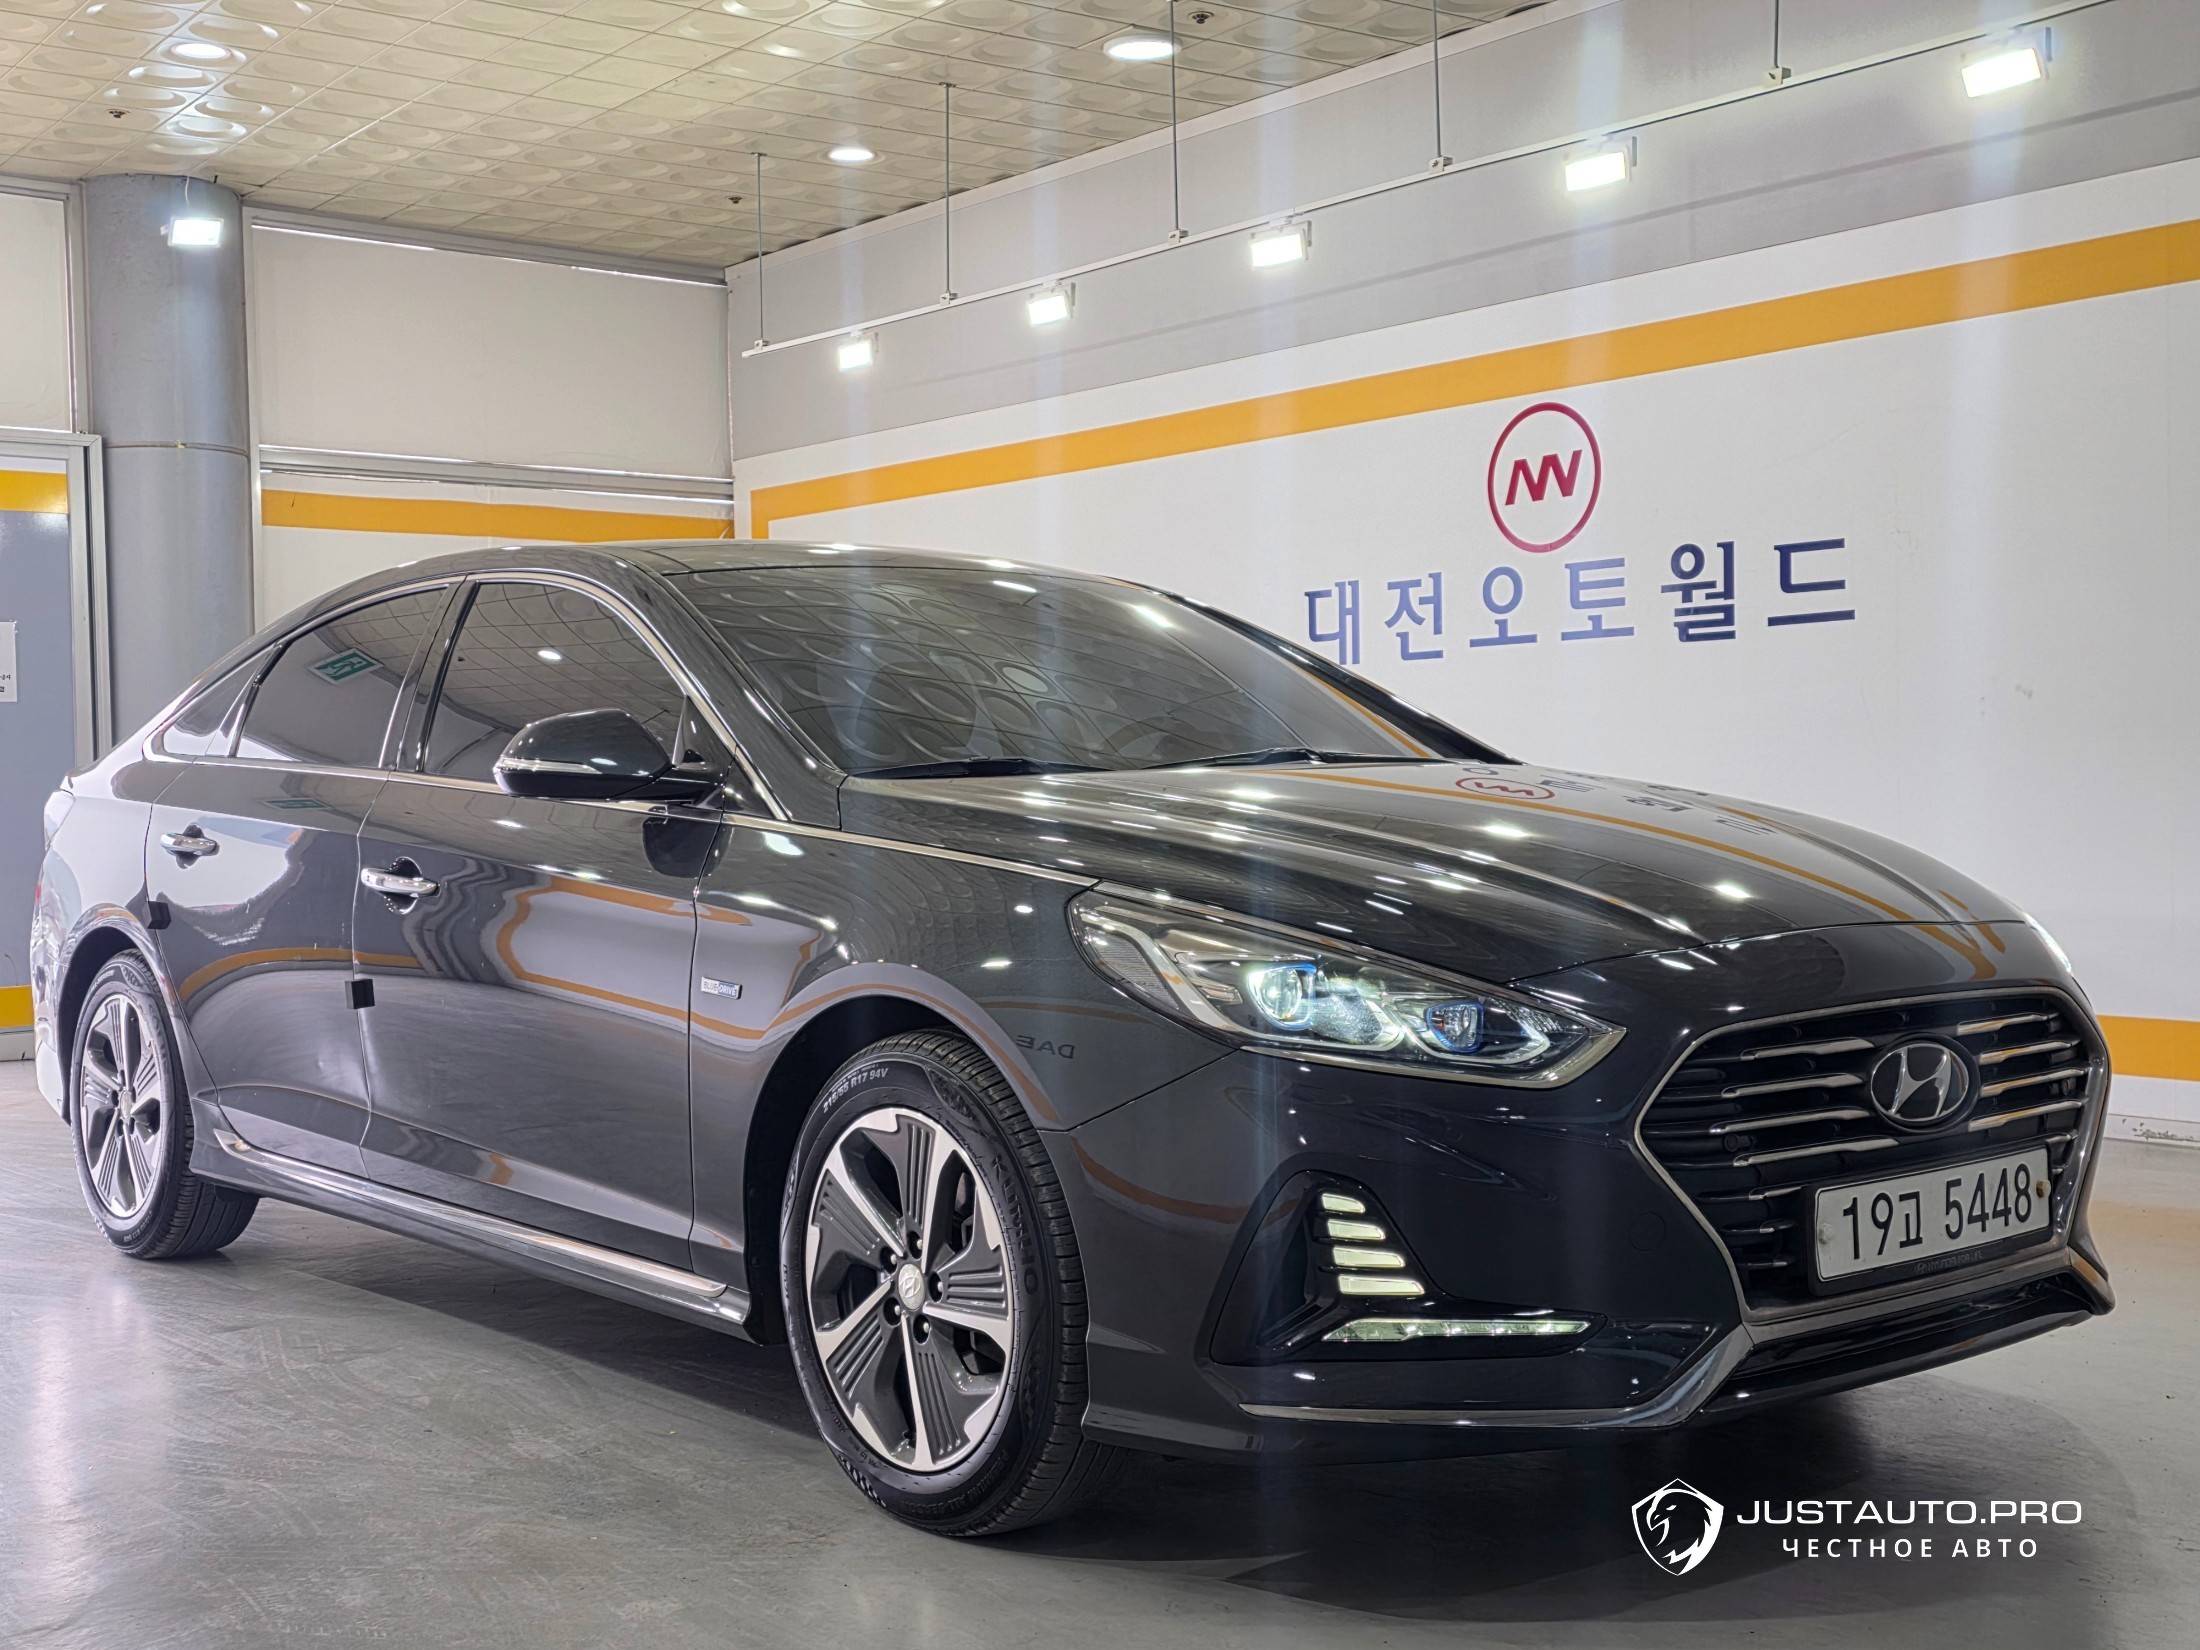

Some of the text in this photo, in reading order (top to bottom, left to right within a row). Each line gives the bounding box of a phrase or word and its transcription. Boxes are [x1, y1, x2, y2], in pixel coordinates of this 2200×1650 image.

[1304, 537, 1856, 666] 대전오토월드
[850, 1071, 869, 1088] R17
[869, 1067, 889, 1080] 94V
[1842, 1163, 2032, 1261] 19고 5448
